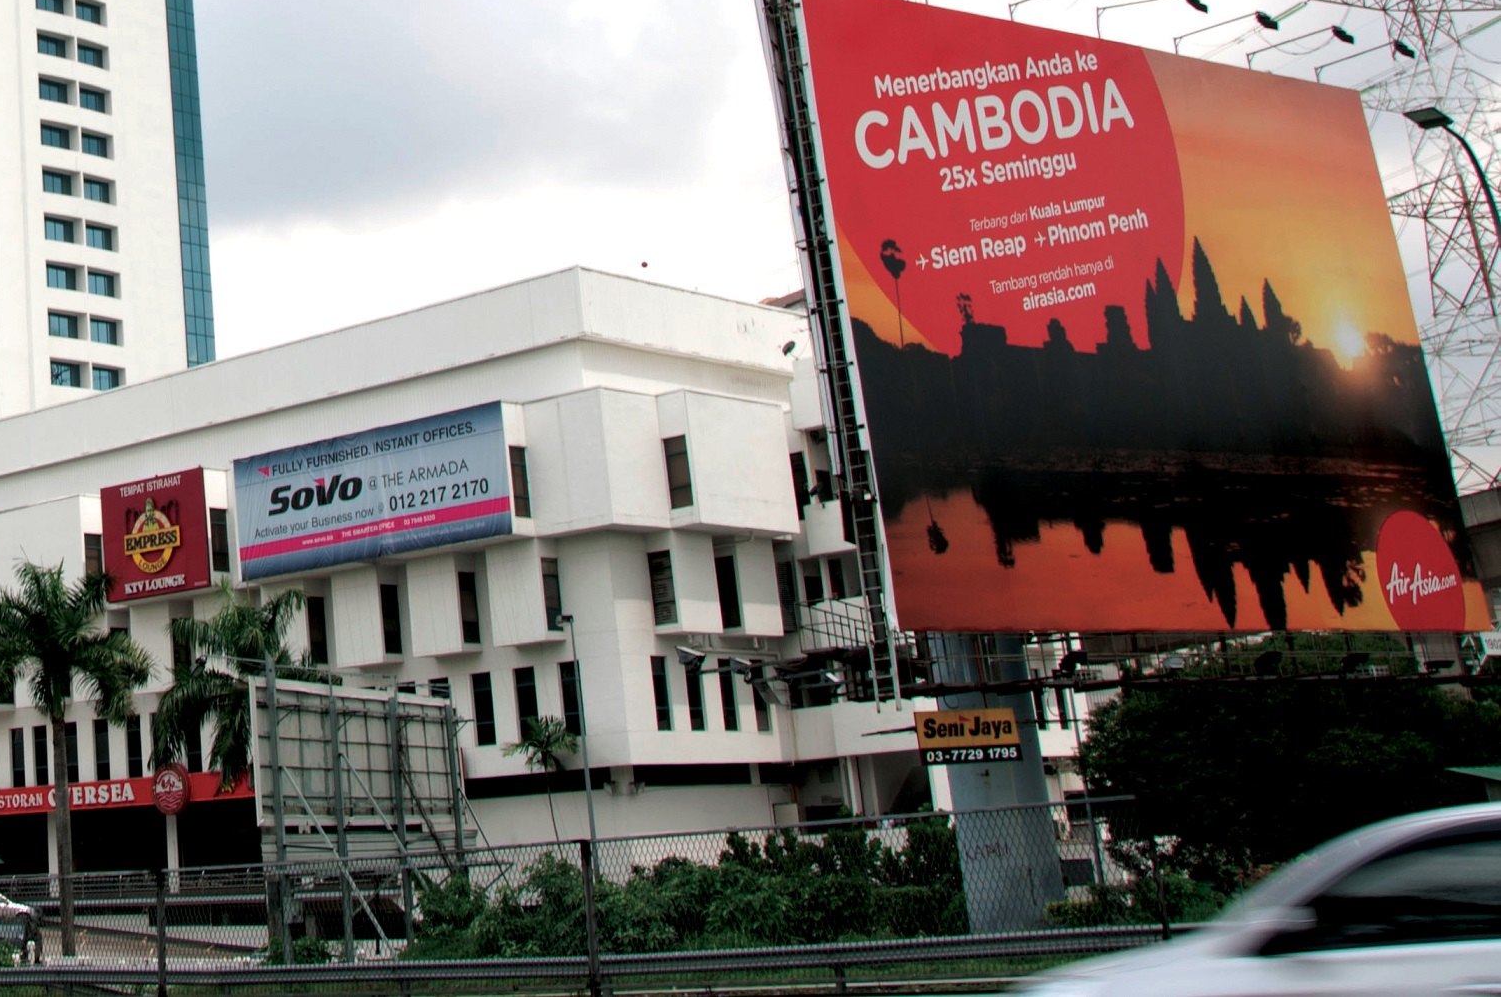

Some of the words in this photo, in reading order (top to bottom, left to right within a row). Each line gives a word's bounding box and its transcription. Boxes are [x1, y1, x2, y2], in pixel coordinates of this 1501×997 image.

[874, 61, 1021, 99] Menerbangkan
[1025, 52, 1073, 80] Anda
[1075, 50, 1098, 73] ke
[854, 77, 1135, 170] CAMBODIA
[939, 165, 978, 192] 25x
[981, 152, 1077, 185] Seminggu
[969, 213, 1008, 233] Terbang
[1010, 209, 1029, 225] dari
[1029, 203, 1061, 221] Kuala
[1063, 195, 1106, 215] Lumpur
[1047, 216, 1107, 247] Phnom
[1108, 207, 1149, 235] Penh
[930, 243, 978, 270] Siem
[980, 233, 1027, 259] Reap
[989, 274, 1038, 295] Tambang
[1039, 264, 1073, 284] rendah
[1074, 259, 1103, 278] hanya
[1104, 255, 1115, 270] di
[1022, 281, 1097, 312] airasia.com
[272, 459, 303, 476] FULLY
[306, 445, 371, 470] FURNISHED.
[373, 433, 420, 453] INSTANT
[423, 421, 476, 443] OFFICES.
[120, 483, 145, 497] TEMPAT
[146, 474, 181, 491] ISTIRAHAT
[368, 475, 379, 491] @
[381, 472, 404, 489] THE
[408, 458, 469, 484] ARMADA
[254, 522, 288, 540] Activate
[289, 519, 310, 535] your
[311, 511, 353, 528] Business
[355, 507, 375, 519] now
[389, 492, 416, 512] 012
[419, 486, 447, 506] 217
[451, 478, 489, 500] 2170
[126, 530, 177, 552] EMPRESS
[139, 559, 166, 572] LOUNGE
[125, 580, 144, 595] KTV
[145, 574, 185, 592] LOUNGE
[923, 718, 965, 739] Seni
[968, 716, 1012, 739] Jaya
[926, 749, 984, 763] 03-7729
[987, 746, 1017, 759] 1795
